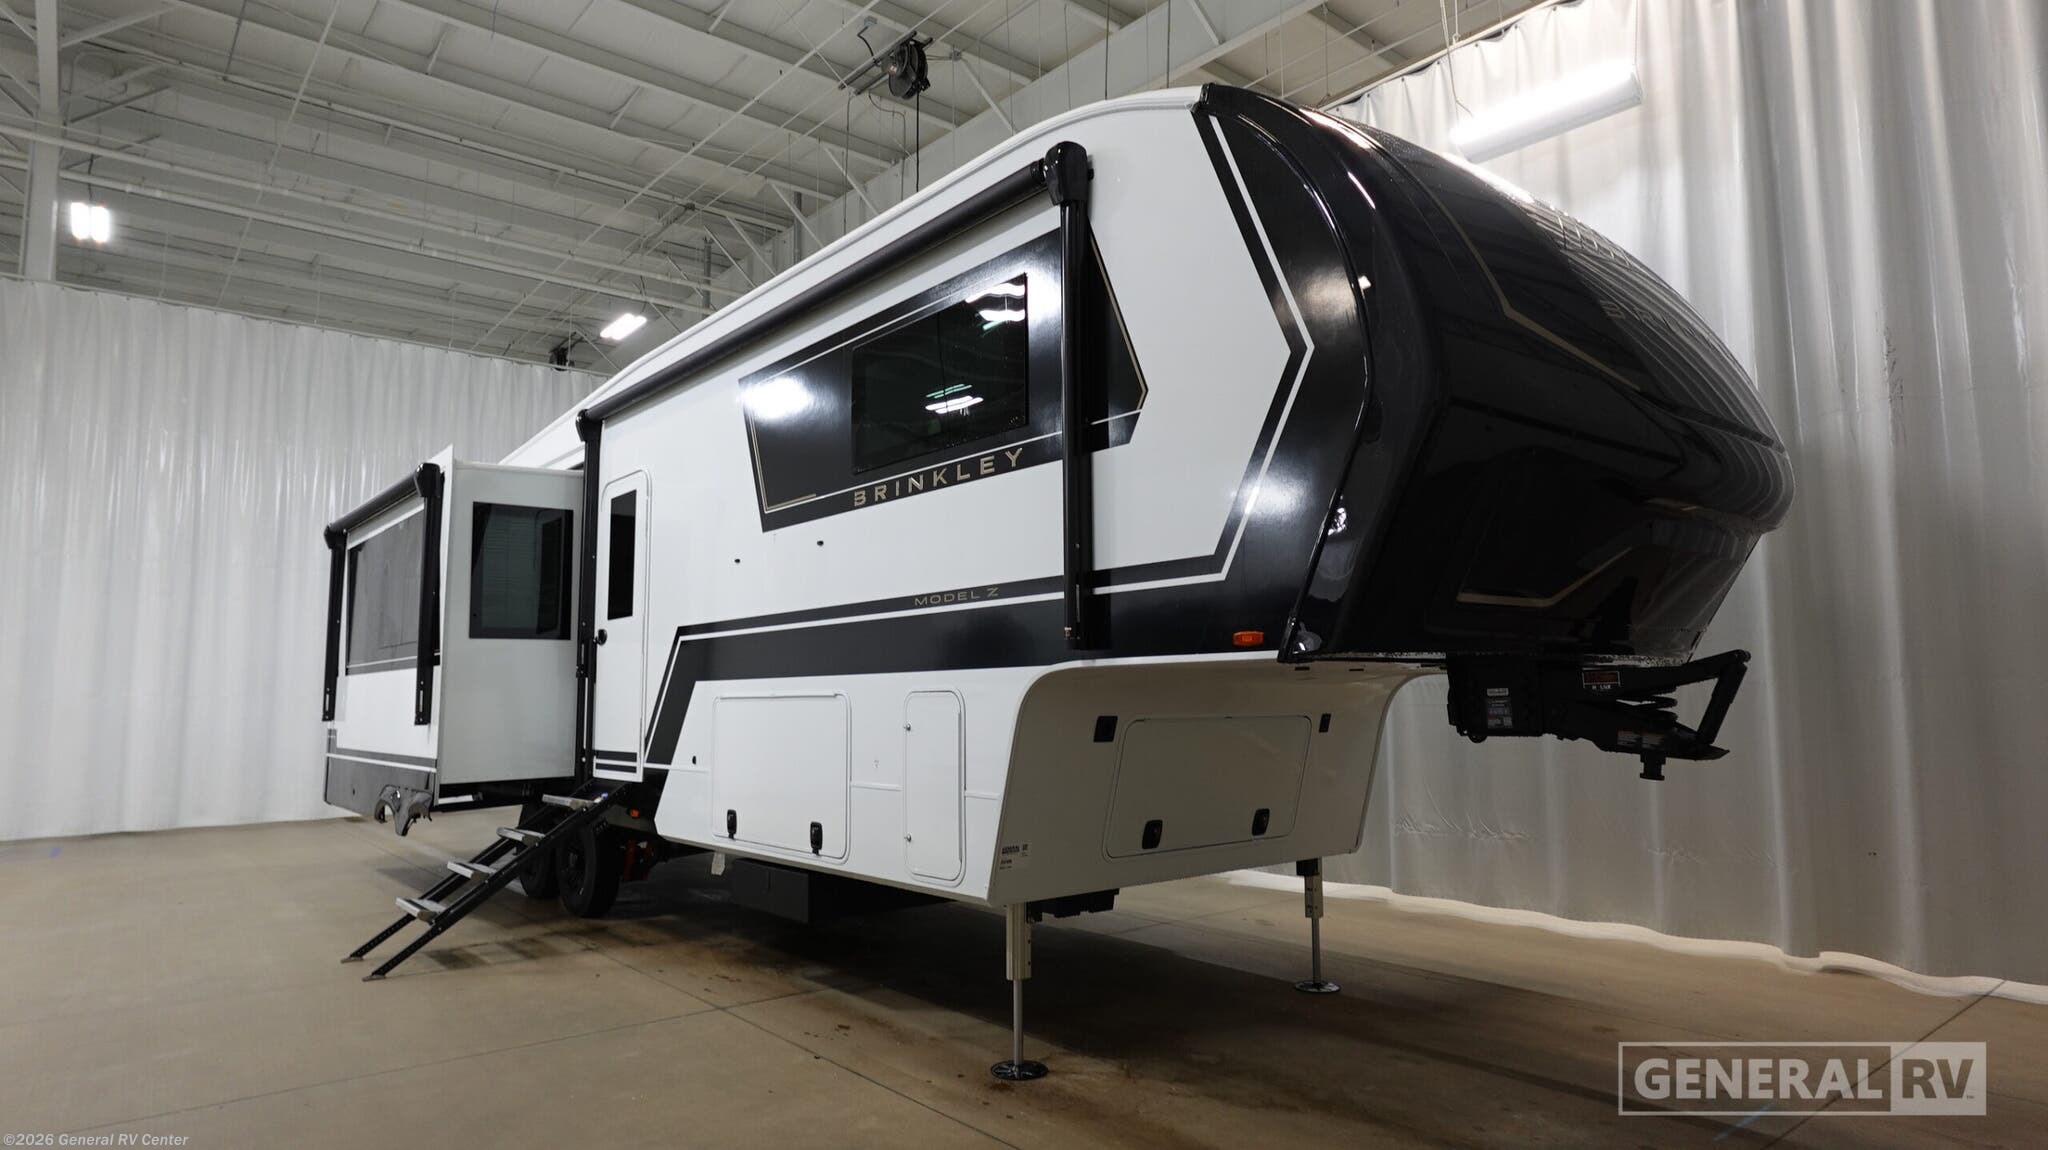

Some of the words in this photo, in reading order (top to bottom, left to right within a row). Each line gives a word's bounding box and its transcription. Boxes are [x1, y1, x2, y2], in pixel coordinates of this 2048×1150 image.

[854, 447, 1023, 507] BRINKLEY
[914, 589, 981, 607] MODEL
[986, 587, 999, 598] Z
